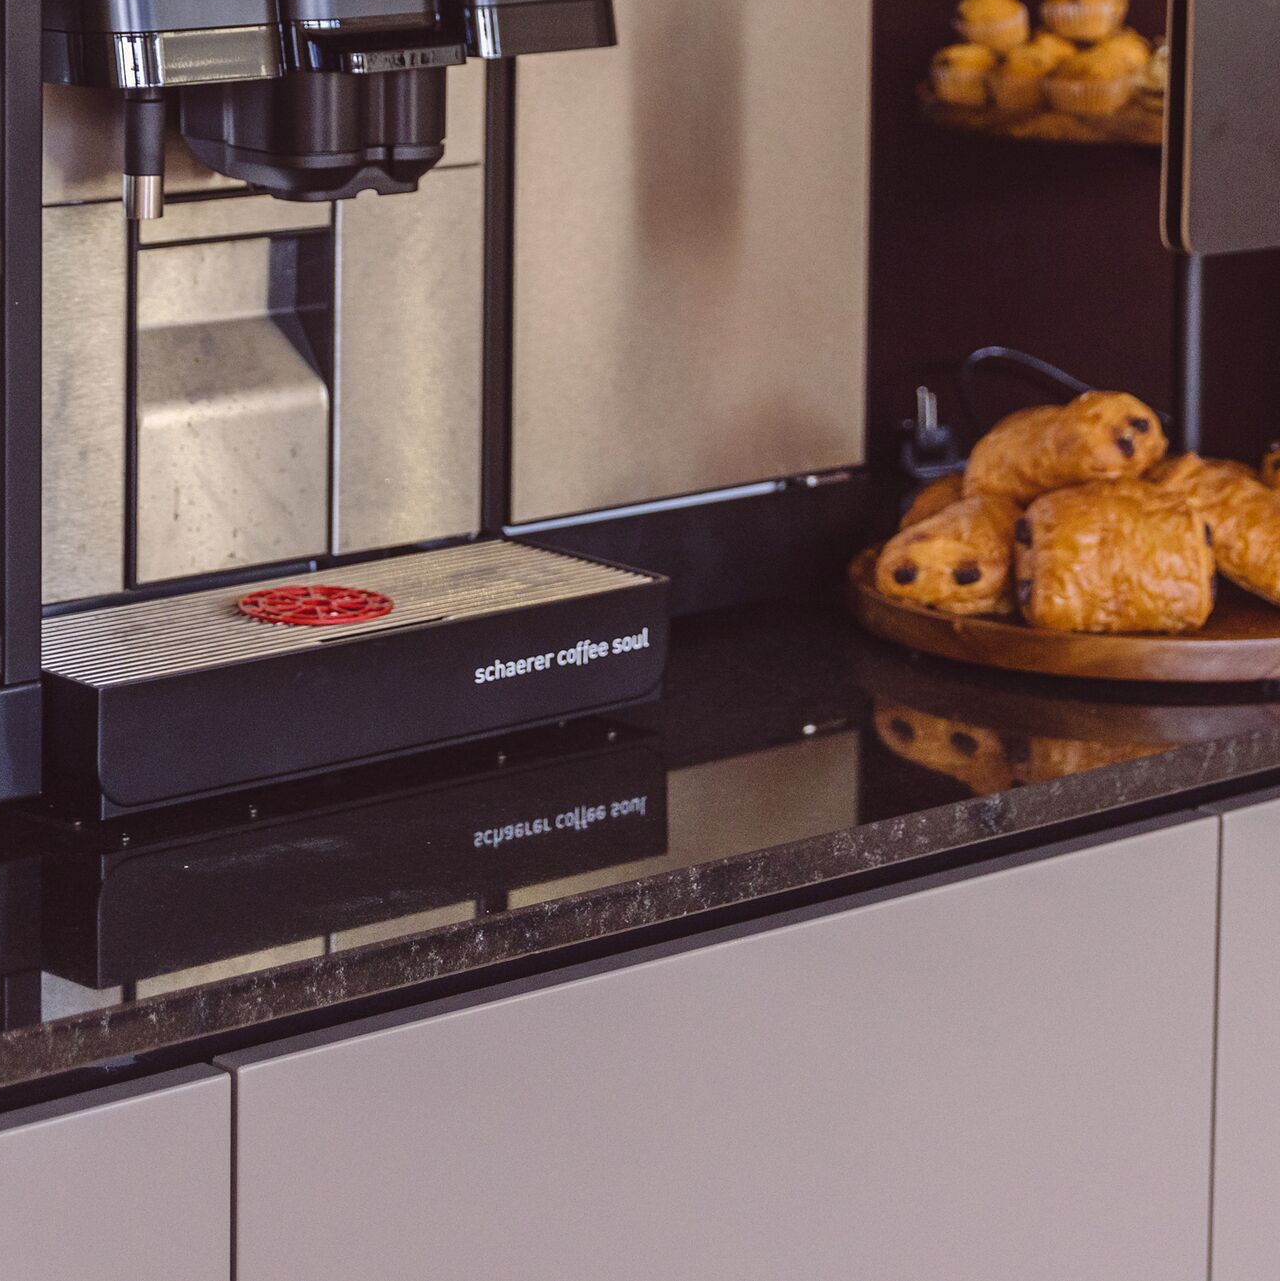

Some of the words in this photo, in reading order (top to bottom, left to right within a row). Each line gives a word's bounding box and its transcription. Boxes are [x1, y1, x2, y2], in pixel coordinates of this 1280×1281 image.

[475, 652, 554, 684] schaerer
[556, 639, 609, 665] coffee
[612, 628, 649, 655] soul
